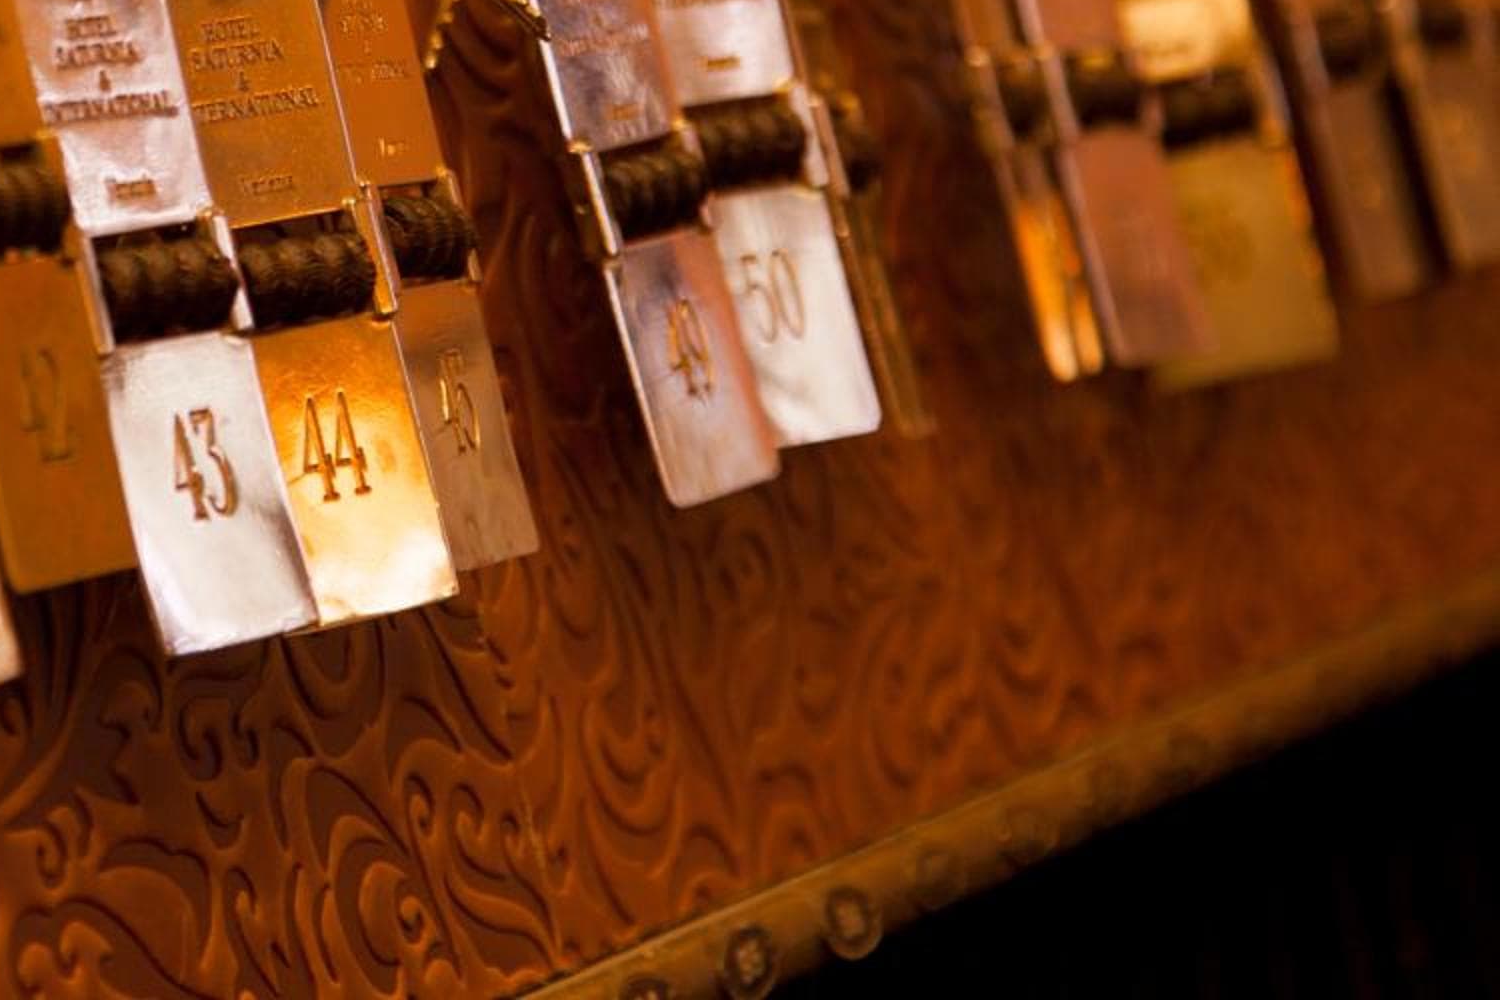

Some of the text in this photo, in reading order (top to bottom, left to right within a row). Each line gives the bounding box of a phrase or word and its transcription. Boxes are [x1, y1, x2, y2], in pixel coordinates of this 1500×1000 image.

[64, 15, 117, 41] HOTEL
[201, 16, 260, 42] HOTEL
[55, 41, 144, 72] SATURNIA
[190, 40, 284, 72] SATURNIA
[737, 248, 806, 344] 50
[303, 390, 373, 503] 44
[171, 407, 240, 522] 43
